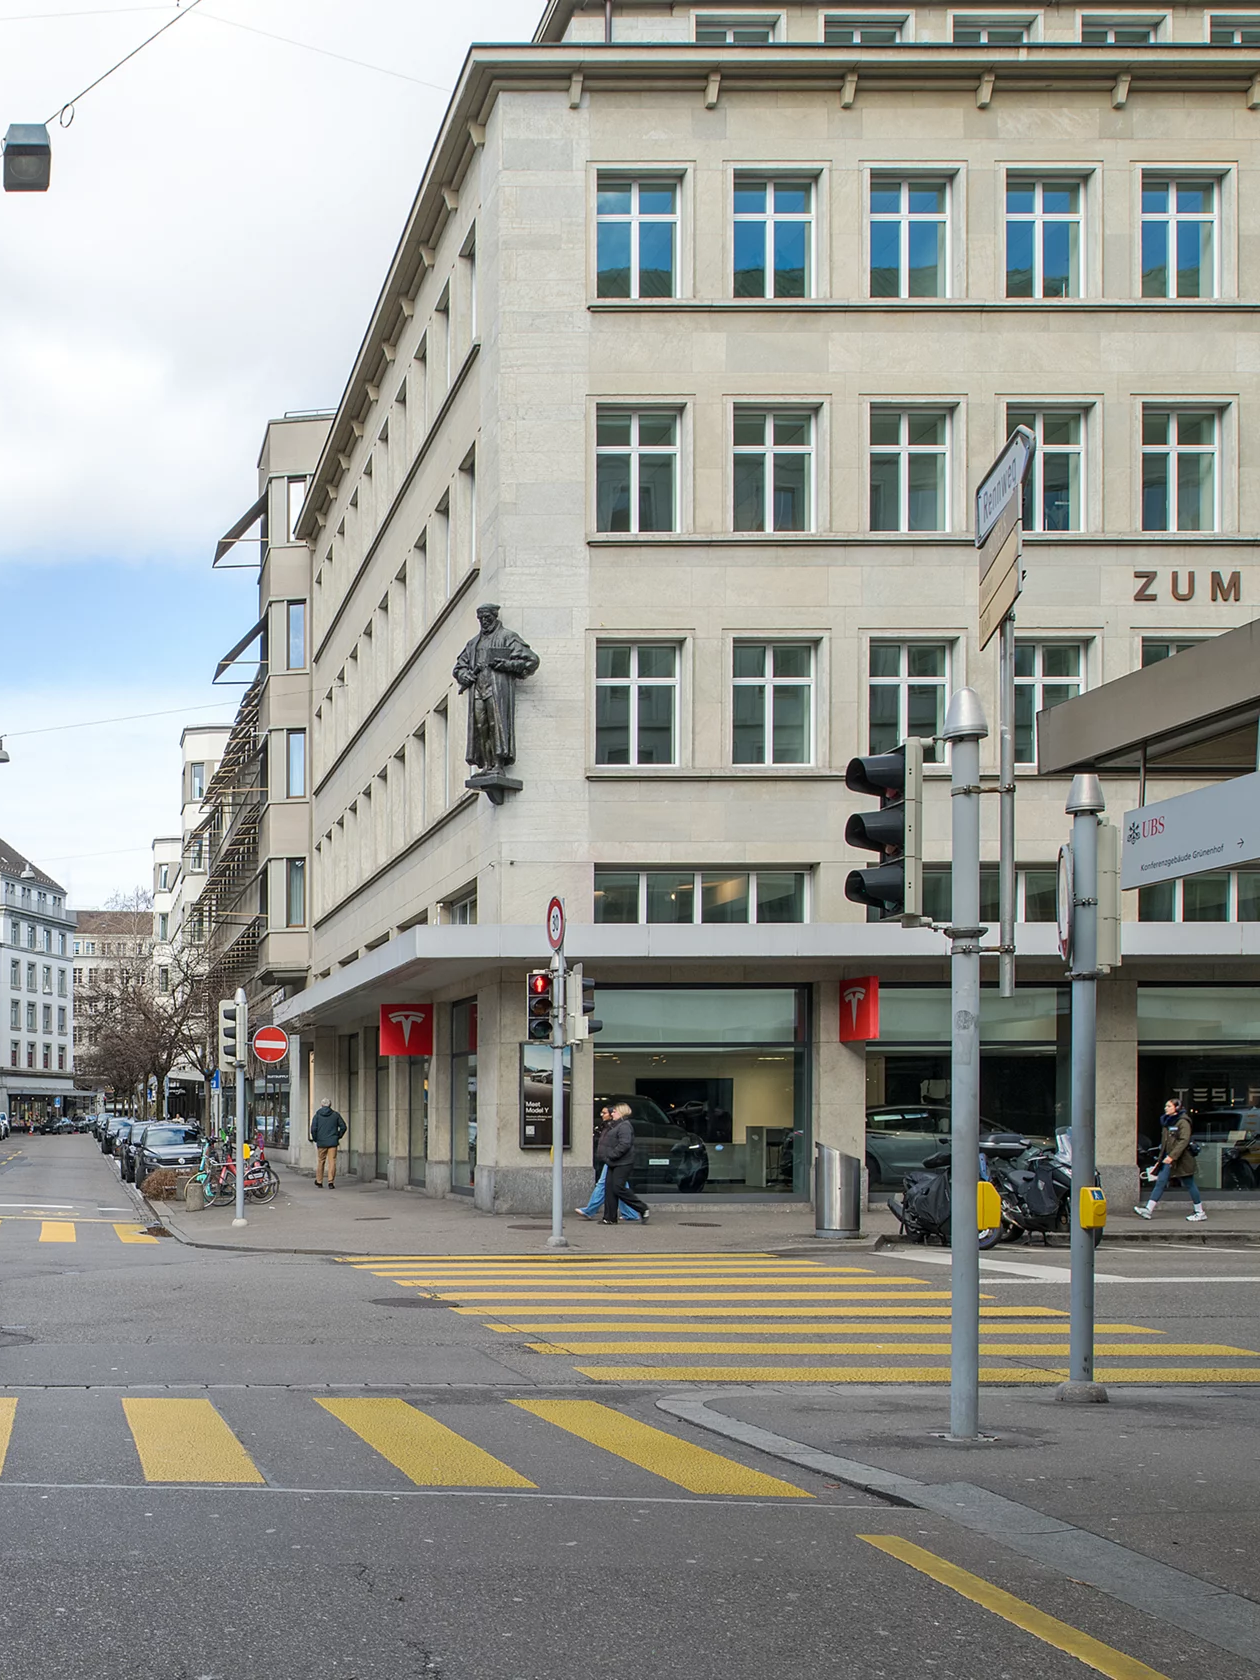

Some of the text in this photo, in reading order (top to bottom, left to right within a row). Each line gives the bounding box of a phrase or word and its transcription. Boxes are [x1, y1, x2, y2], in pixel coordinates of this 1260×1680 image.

[983, 458, 1017, 523] Rennweg
[1134, 571, 1241, 602] ZUM
[1142, 816, 1165, 838] UBS
[1141, 844, 1224, 871] Konferenzgebäude Grünenhof
[552, 914, 560, 932] 30
[1172, 1088, 1260, 1102] TESLA
